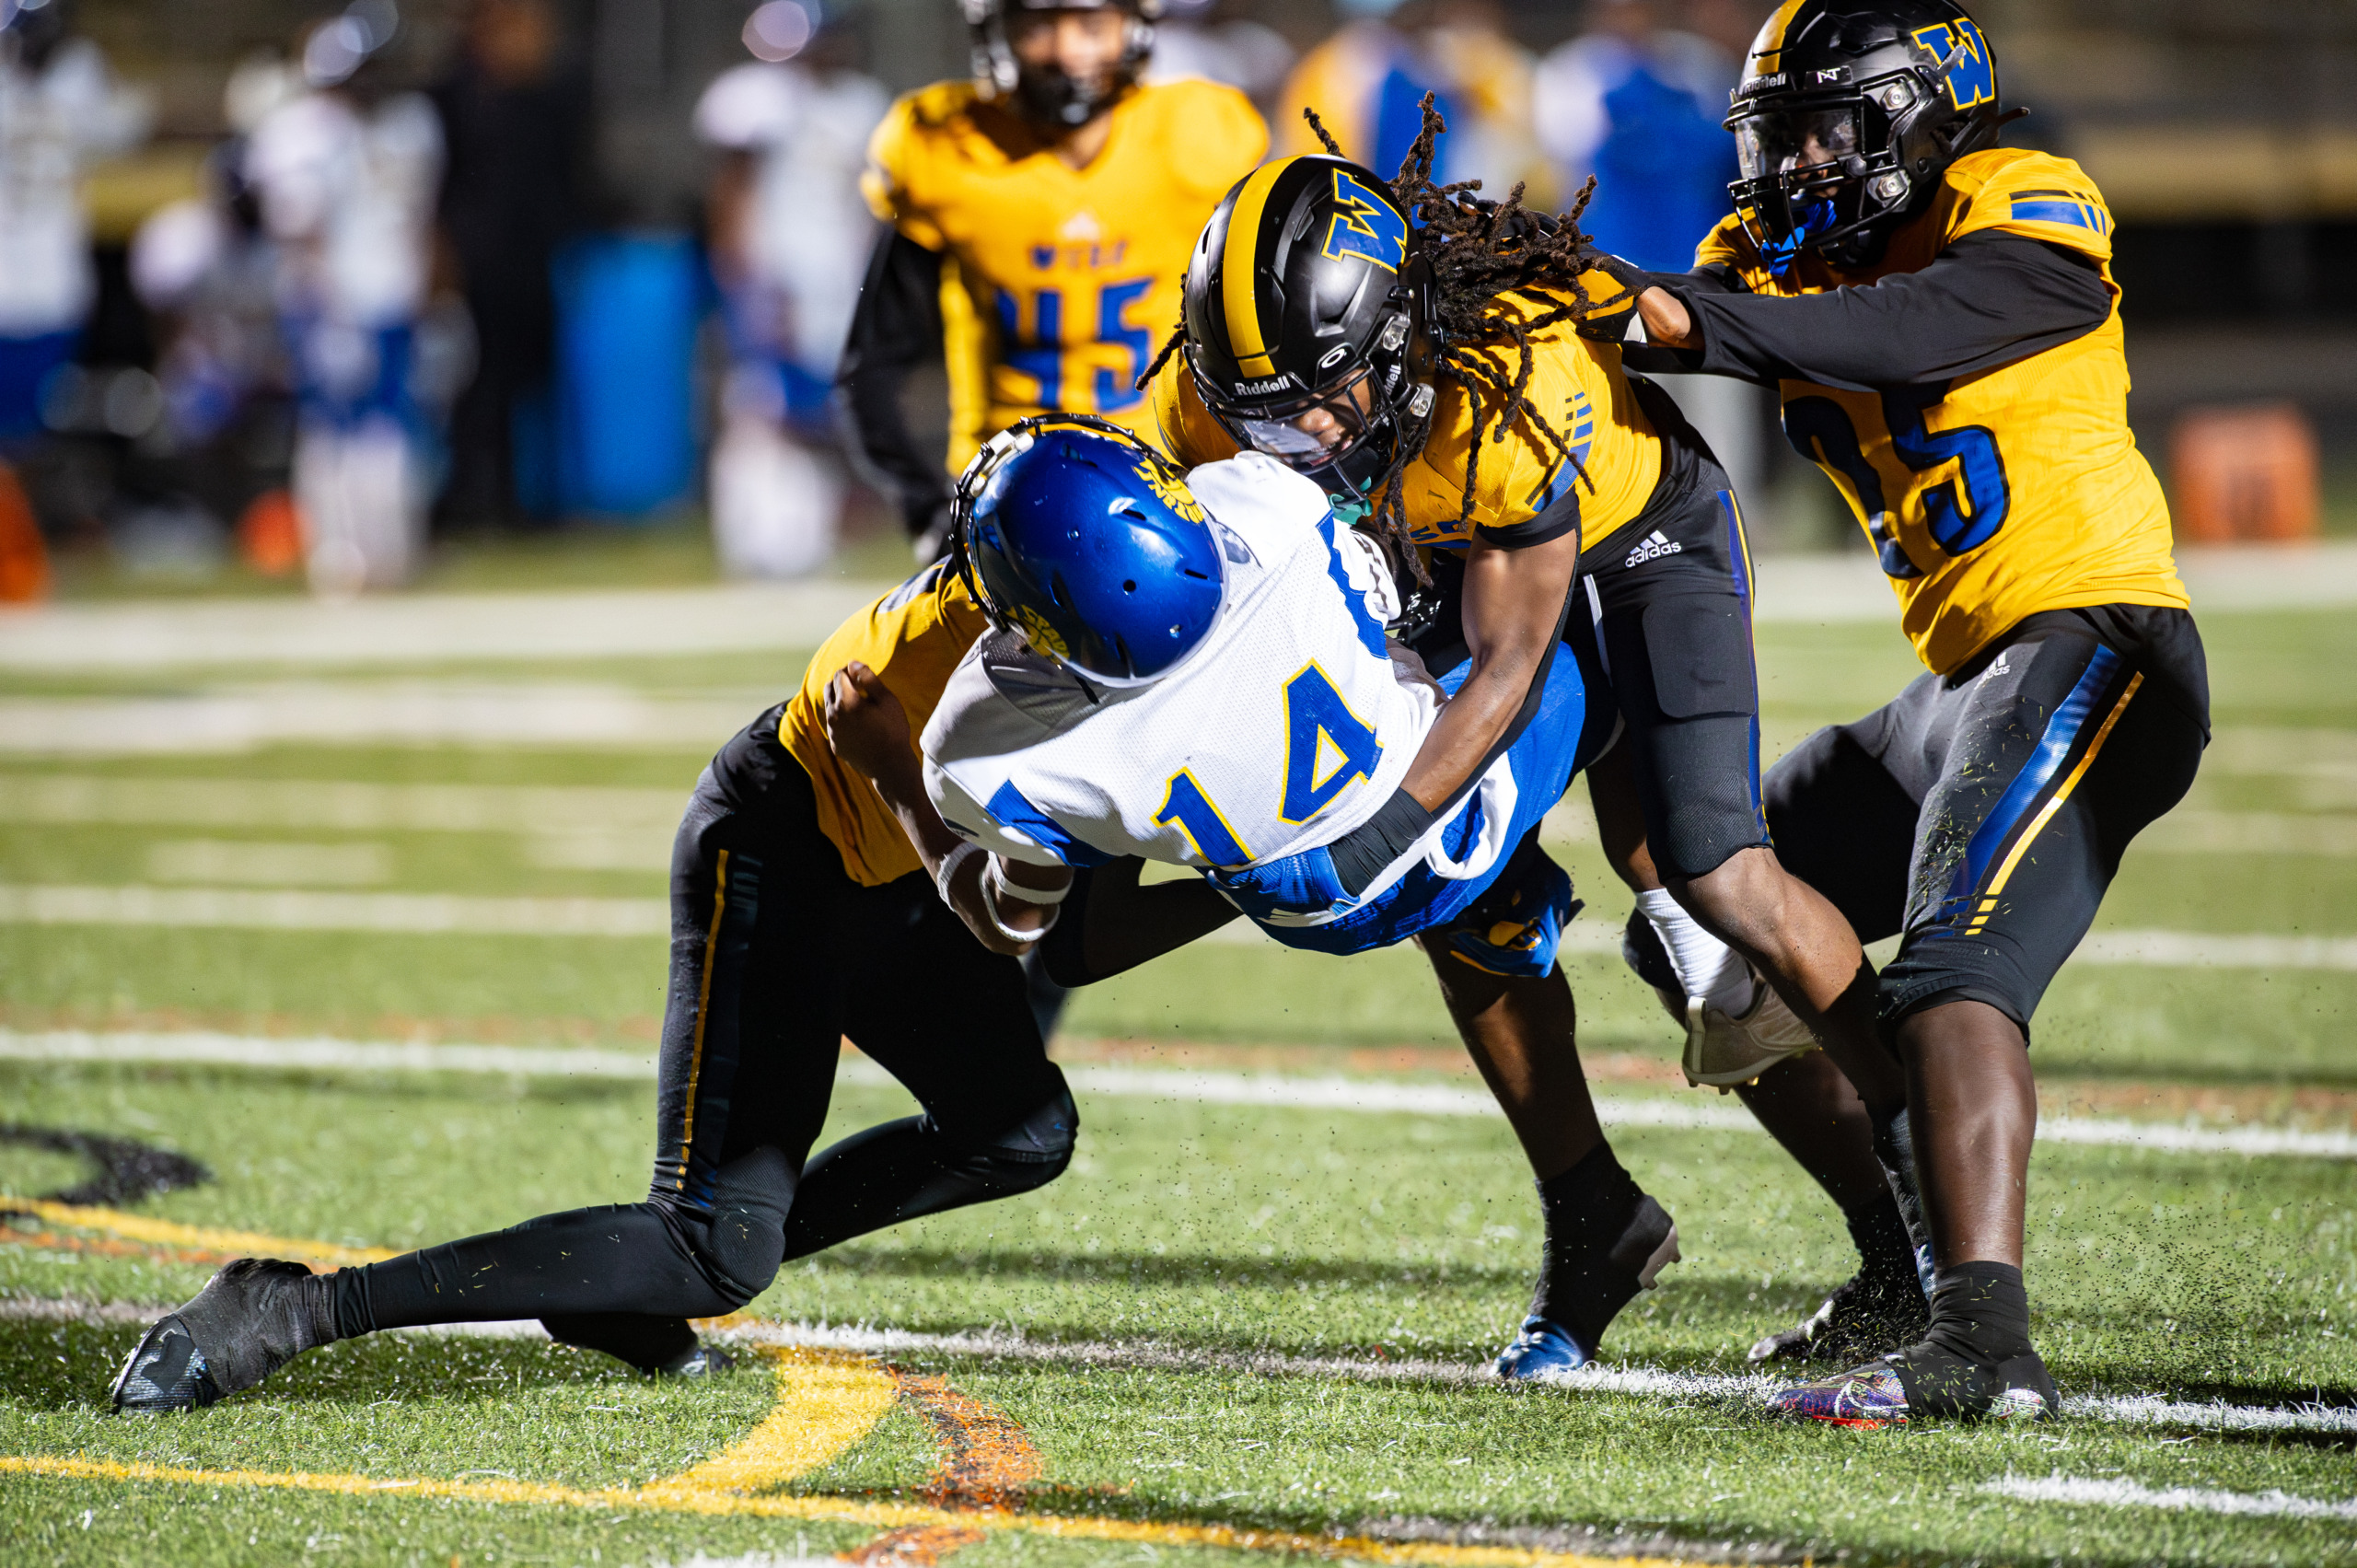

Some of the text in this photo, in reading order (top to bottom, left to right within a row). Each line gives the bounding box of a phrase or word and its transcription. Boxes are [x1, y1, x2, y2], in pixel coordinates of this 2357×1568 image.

[1912, 17, 1995, 110] W
[1321, 168, 1408, 274] W
[994, 276, 1154, 412] 45
[1235, 375, 1290, 396] Riddell
[1625, 541, 1681, 568] adidas
[1150, 656, 1384, 868] 14
